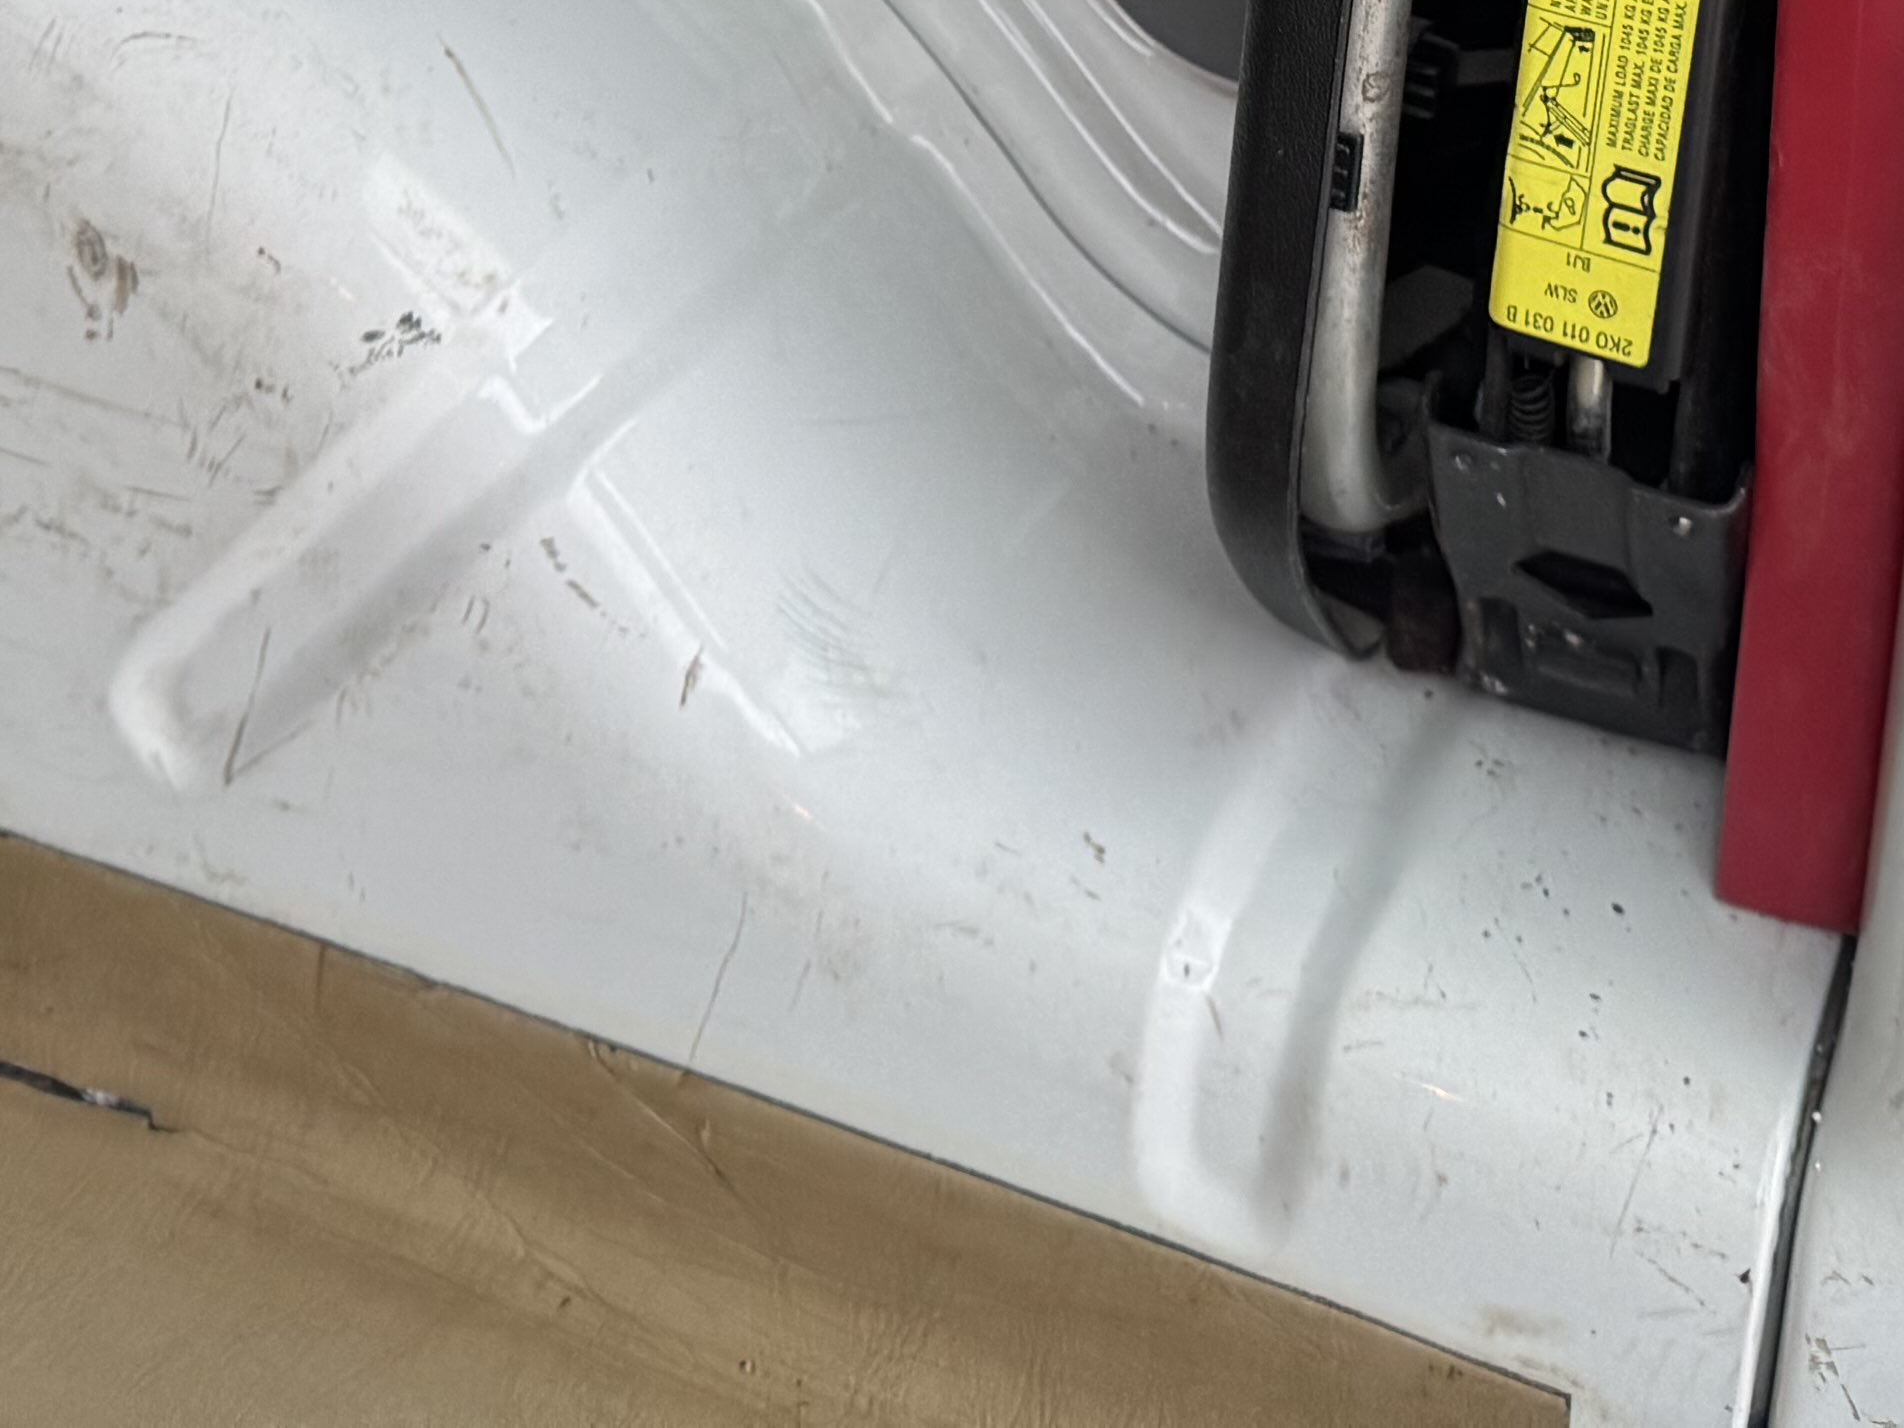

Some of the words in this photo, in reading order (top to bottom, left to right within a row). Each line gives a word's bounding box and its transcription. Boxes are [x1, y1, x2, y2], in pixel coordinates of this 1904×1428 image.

[1623, 4, 1636, 20] KG
[1640, 8, 1652, 25] KG
[1657, 6, 1670, 23] KG
[1619, 23, 1633, 50] 1045
[1635, 28, 1649, 55] 1045
[1652, 26, 1667, 54] 1045
[1649, 56, 1662, 74] DE
[1666, 34, 1682, 73] CARGA
[1614, 54, 1628, 86] LOAD
[1644, 76, 1659, 107] MAXI
[1663, 76, 1676, 93] DE
[1605, 88, 1624, 148] MAXIMUM
[1620, 90, 1640, 151] TRAGLAST
[1653, 94, 1673, 161] CAPACIDAD
[1637, 109, 1655, 157] CHARGE
[1524, 308, 1554, 333] 031
[1562, 320, 1589, 343] 011
